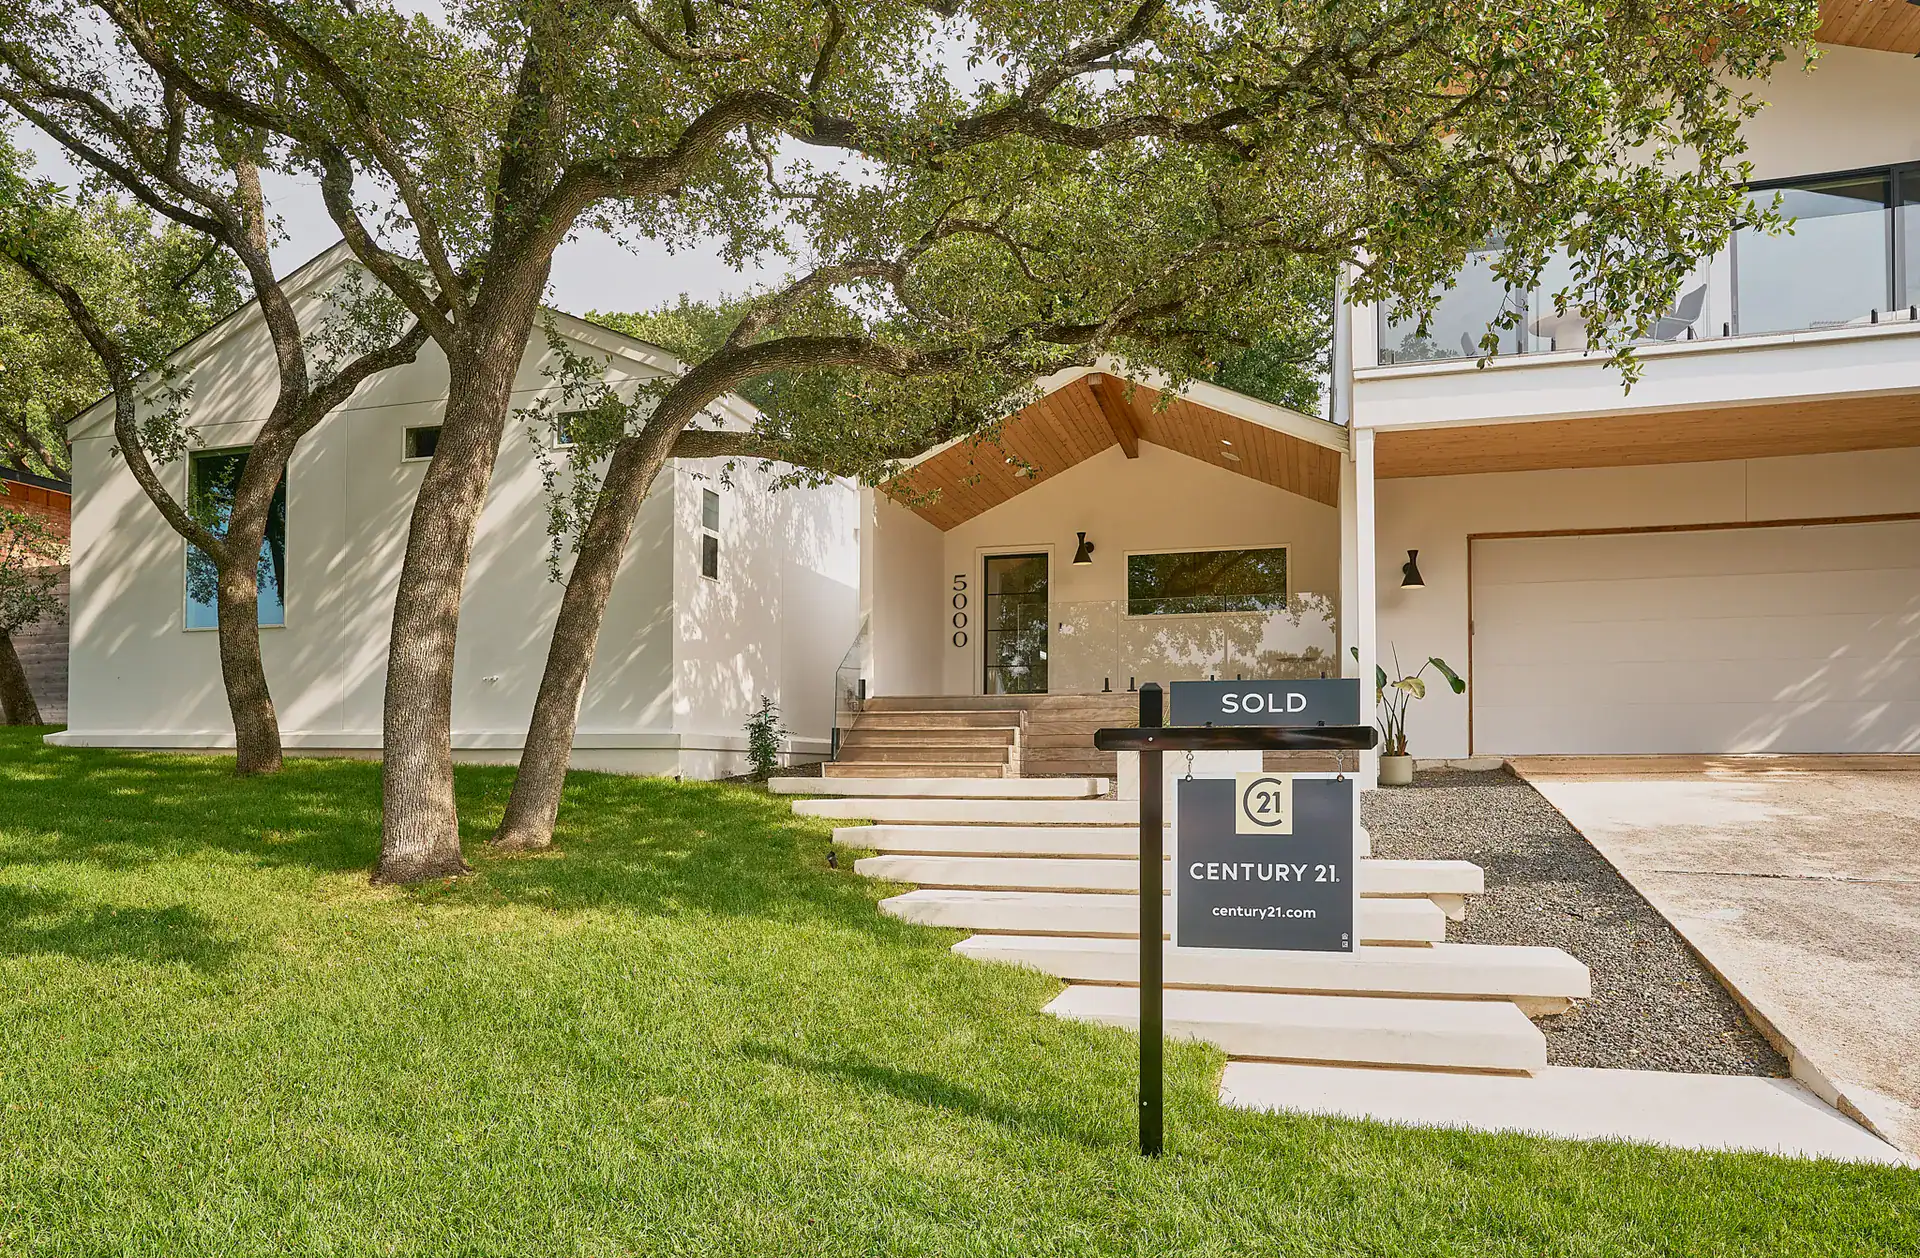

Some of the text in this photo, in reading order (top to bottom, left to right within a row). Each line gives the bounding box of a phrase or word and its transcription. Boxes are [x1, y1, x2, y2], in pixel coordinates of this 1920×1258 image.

[952, 573, 969, 648] 5000
[1221, 692, 1307, 714] SOLD
[1189, 862, 1308, 882] CENTURY
[1212, 905, 1317, 920] century21.com
